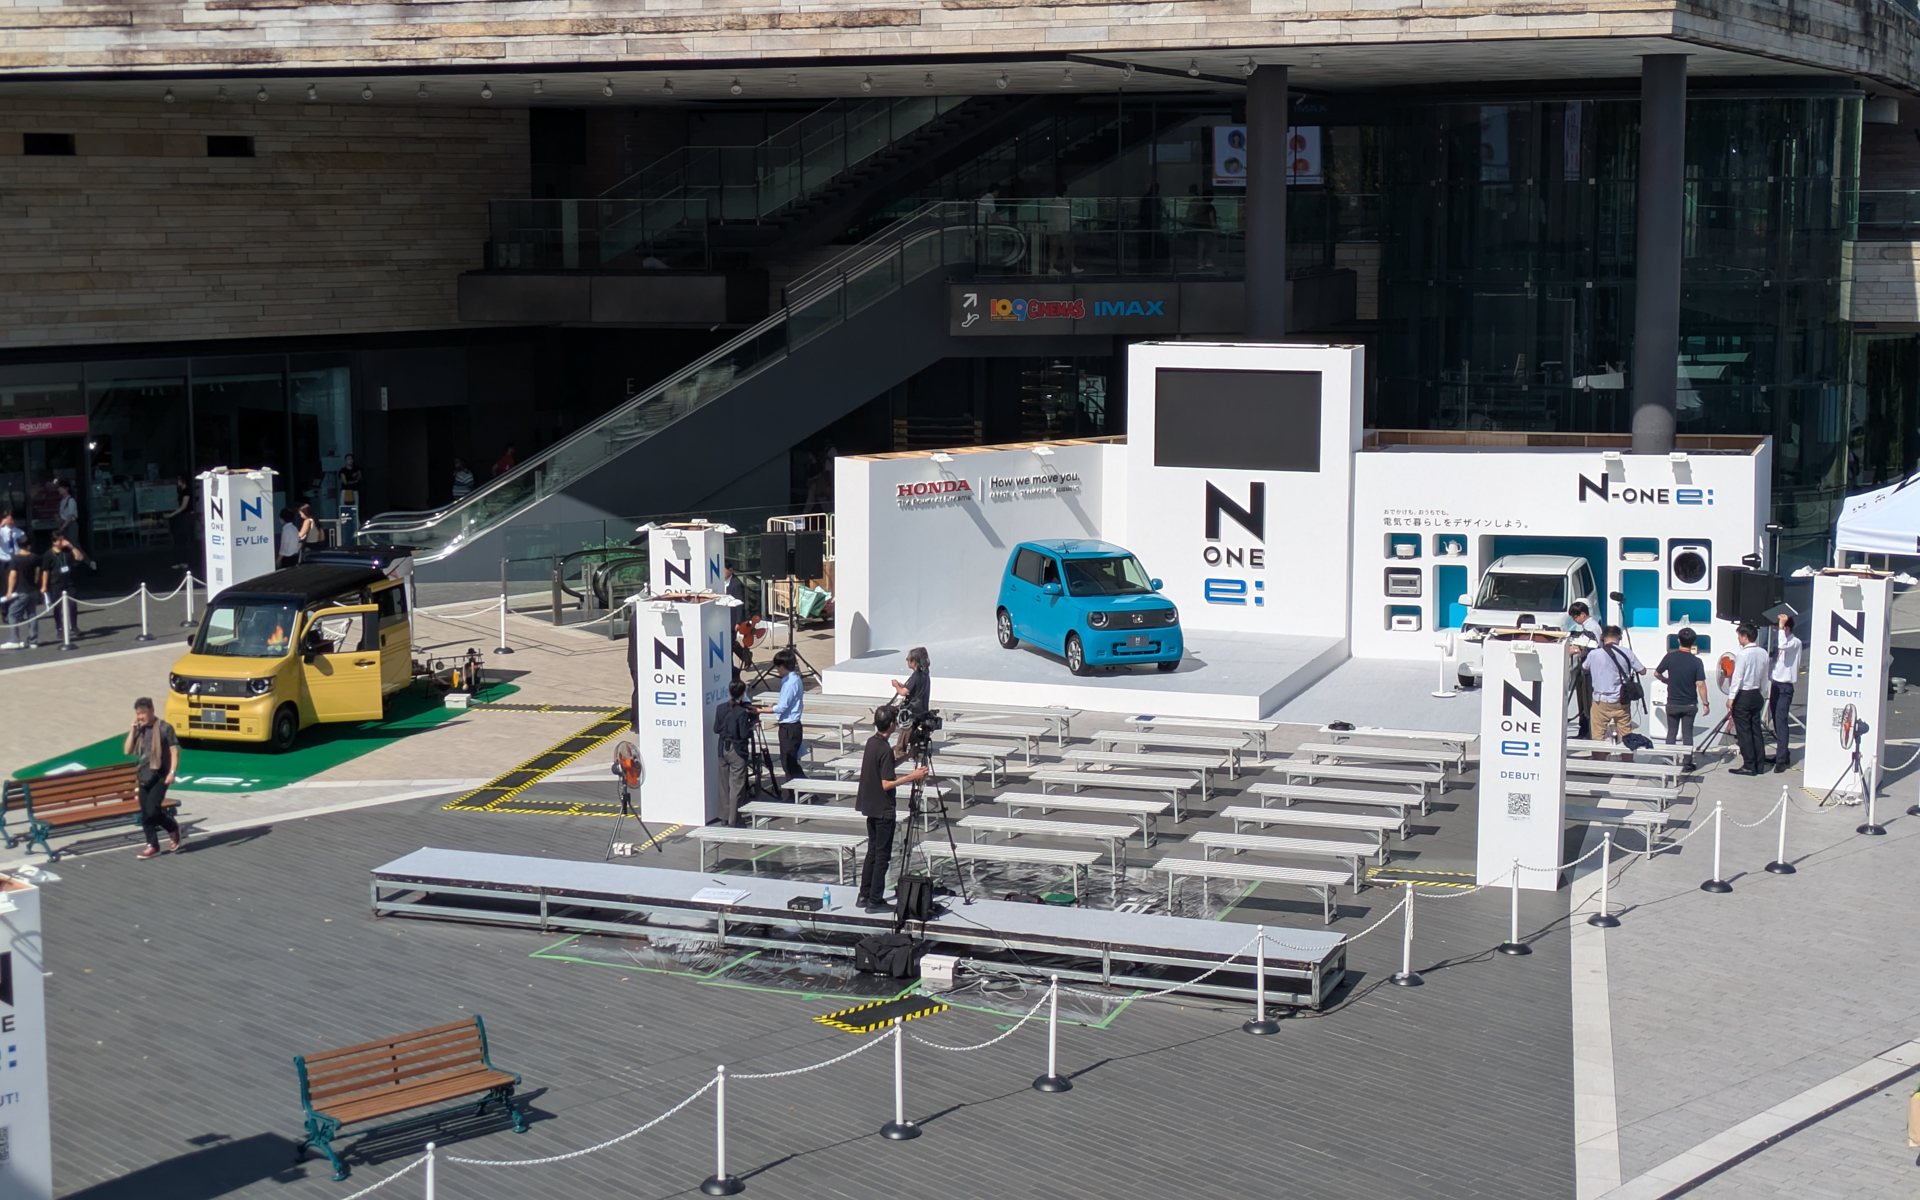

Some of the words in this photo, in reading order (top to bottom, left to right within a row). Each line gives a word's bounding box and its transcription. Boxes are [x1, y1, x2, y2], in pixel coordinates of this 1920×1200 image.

[990, 299, 1027, 321] 109
[1027, 298, 1085, 319] CINEMAS
[1095, 301, 1164, 316] IMAX
[19, 422, 53, 432] Rakuten
[897, 479, 972, 497] HONDA
[990, 475, 1012, 489] How
[1016, 475, 1030, 486] we
[1033, 473, 1059, 486] move
[1060, 472, 1080, 485] you.
[211, 498, 224, 520] N
[241, 497, 262, 521] N
[1205, 480, 1265, 542] N
[211, 522, 224, 531] ONE
[1383, 517, 1528, 528] 電気で暮らしをデザインしよう。
[235, 536, 250, 547] EV
[251, 535, 269, 545] Life
[1203, 546, 1265, 567] ONE
[664, 558, 691, 586] N
[710, 553, 720, 584] N
[1830, 610, 1866, 644] N
[653, 636, 685, 670] N
[708, 631, 724, 669] N
[1828, 645, 1864, 657] ONE
[653, 673, 685, 685] ONE
[713, 674, 721, 683] for
[705, 690, 715, 705] EV
[715, 685, 729, 700] Life
[1502, 679, 1542, 718] N
[1826, 689, 1862, 698] DEBUT!
[655, 719, 687, 727] DEBUT!
[1501, 720, 1541, 733] ONE
[1500, 771, 1540, 781] DEBUT!
